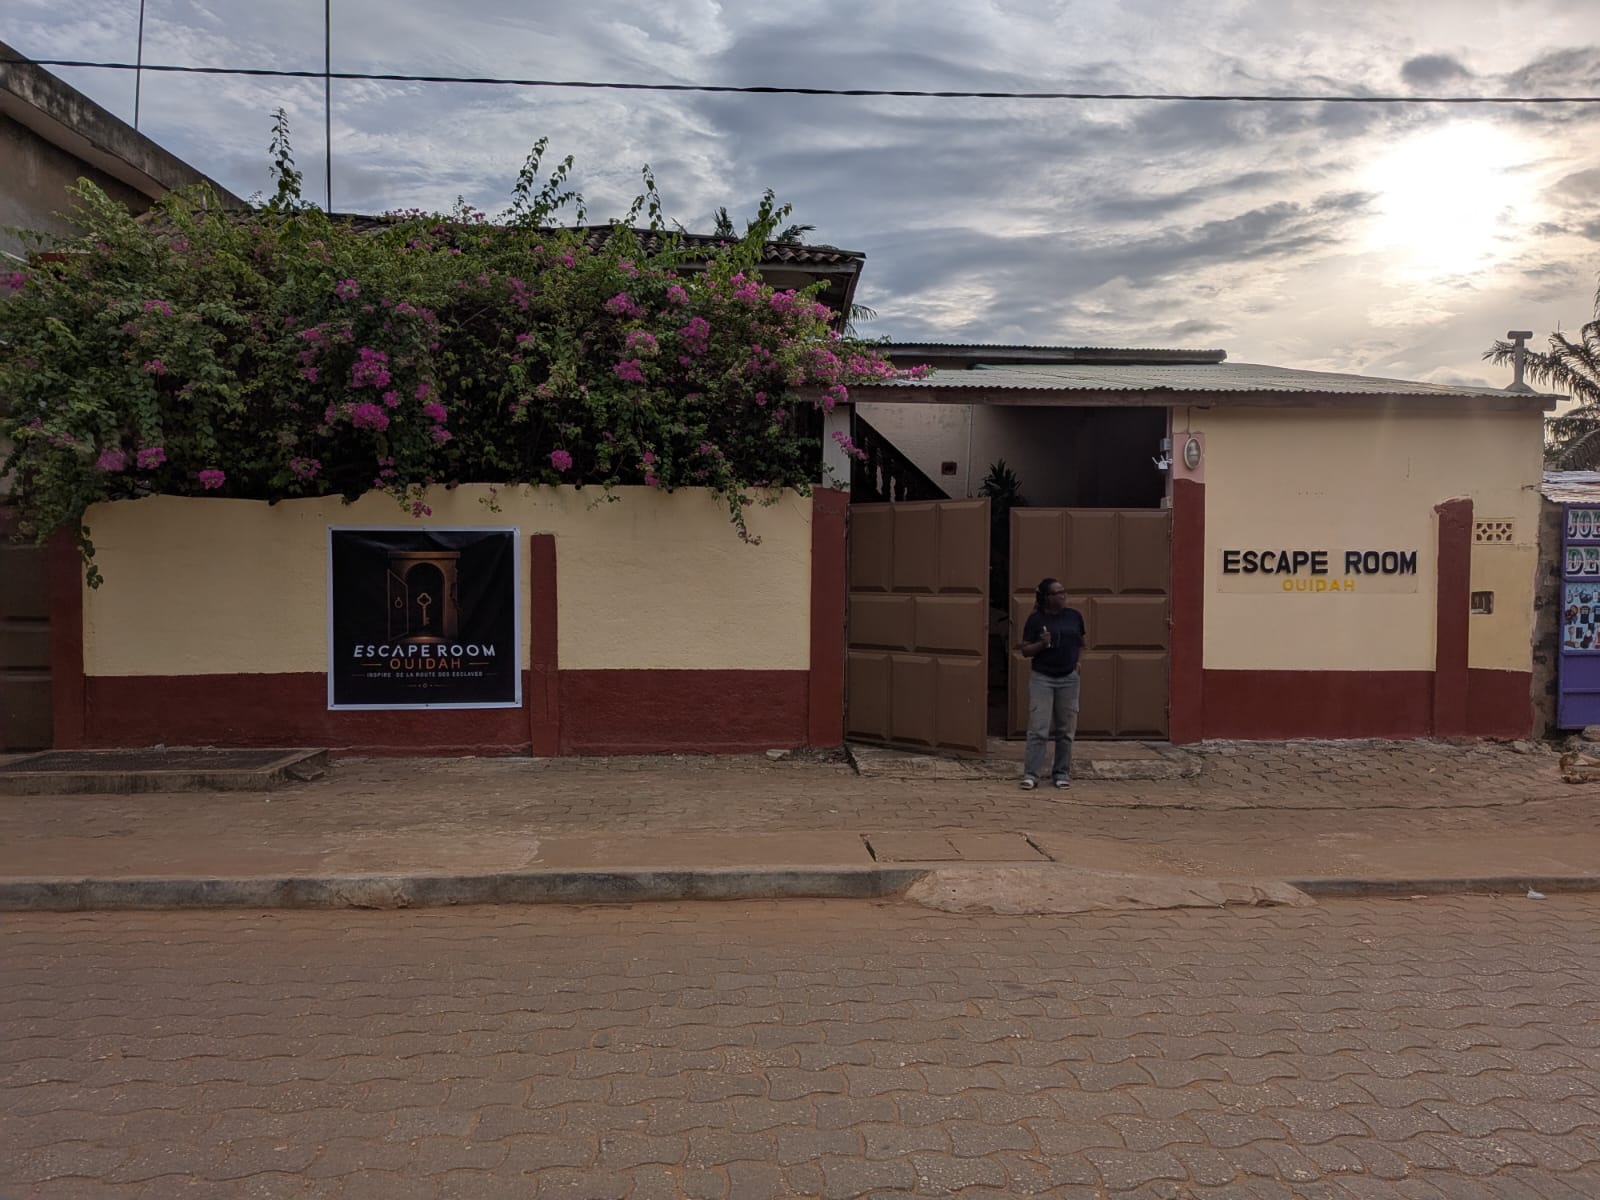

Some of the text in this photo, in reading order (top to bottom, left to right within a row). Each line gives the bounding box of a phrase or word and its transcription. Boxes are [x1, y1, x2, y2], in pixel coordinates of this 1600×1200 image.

[1223, 550, 1417, 575] ESCAPE ROOM
[1282, 578, 1356, 592] OUIDAH
[353, 644, 496, 658] ESCAPE ROOM
[389, 658, 461, 670] OUIDAH
